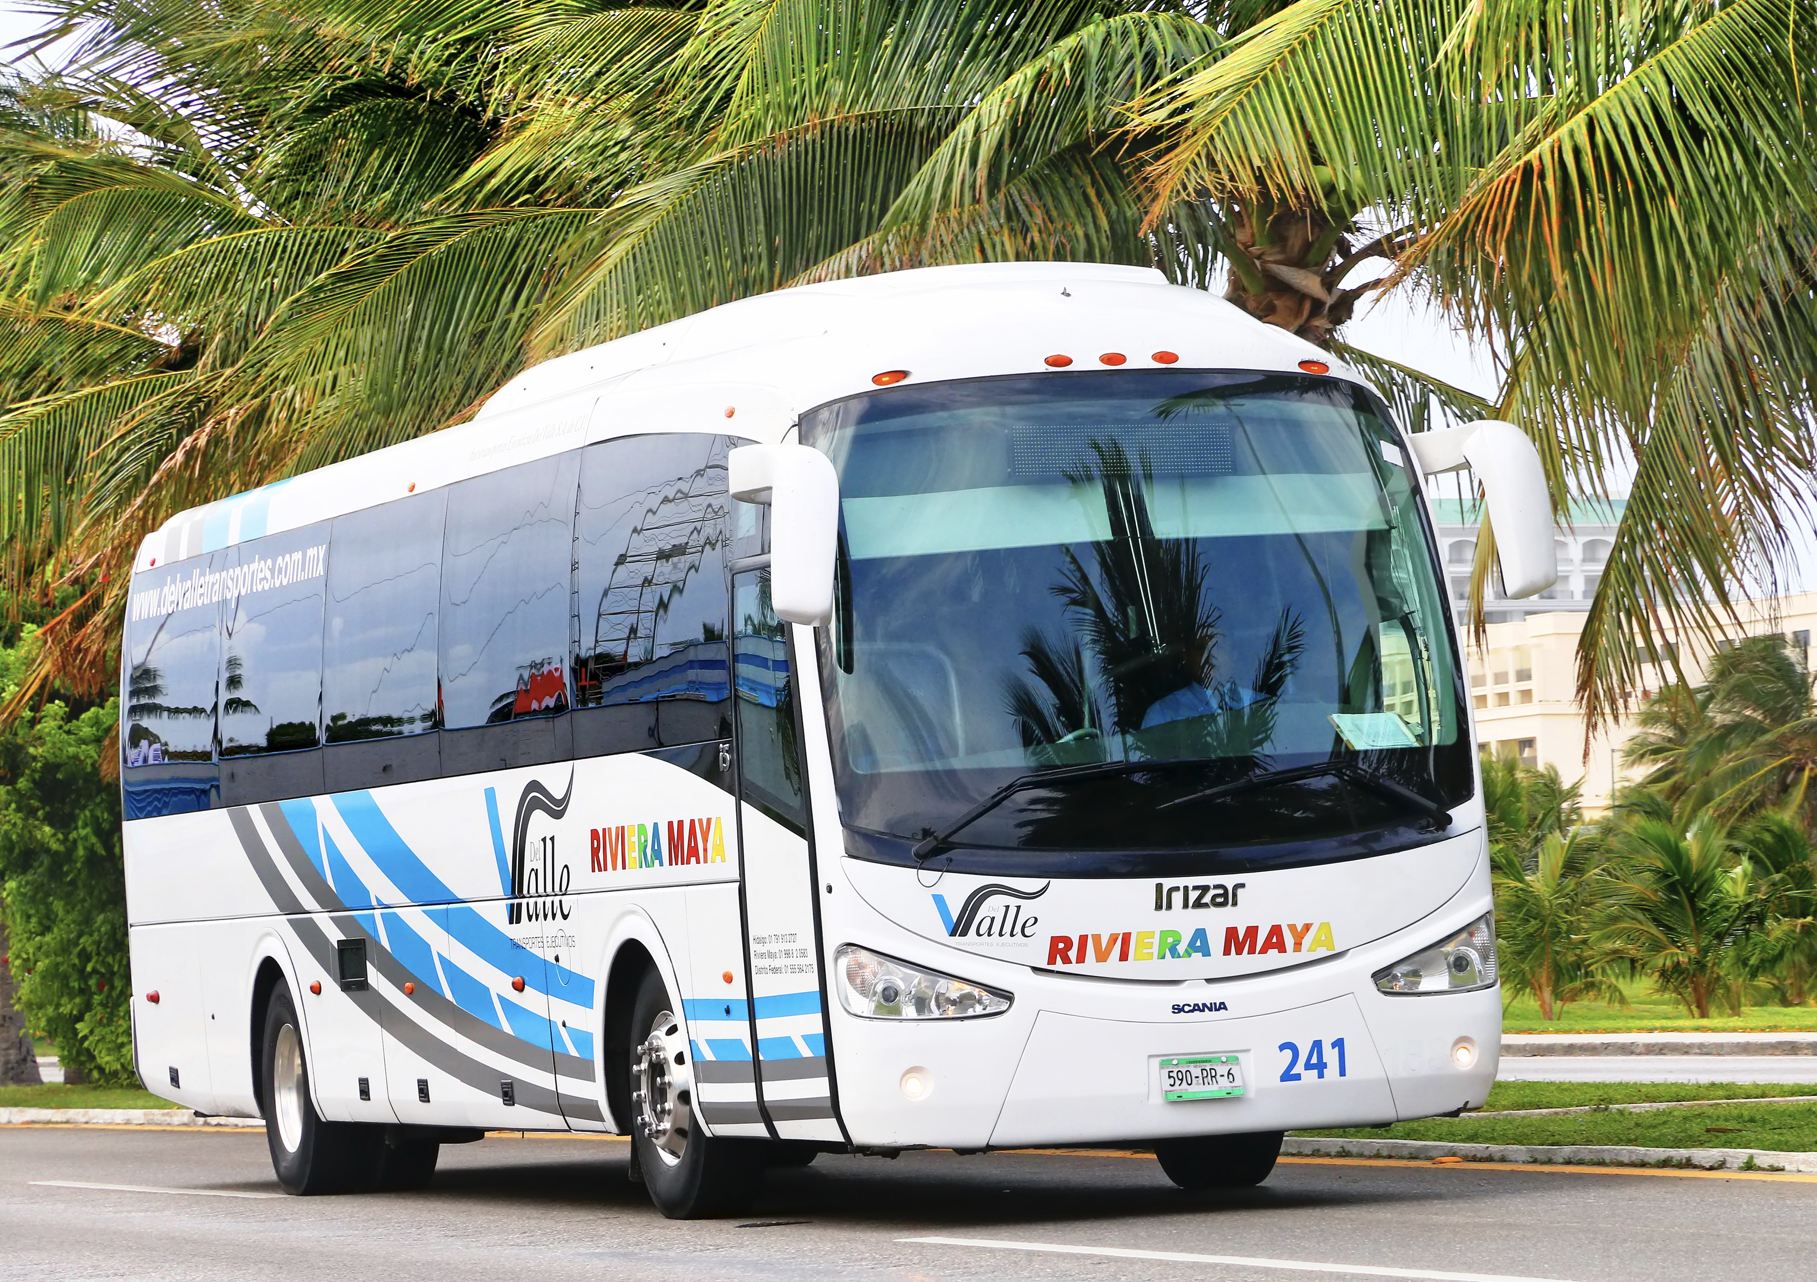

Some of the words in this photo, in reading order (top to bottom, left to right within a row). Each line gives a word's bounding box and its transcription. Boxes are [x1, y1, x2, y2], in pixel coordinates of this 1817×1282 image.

[131, 544, 326, 622] www.delvalletransportes.com.mx
[484, 762, 574, 925] Valle
[529, 840, 541, 862] Del
[590, 822, 664, 873] RIVIERA
[667, 817, 726, 867] MAYA
[931, 880, 1050, 938] Valle
[1154, 882, 1246, 911] Irizar
[510, 936, 544, 950] TRANSPORTES
[545, 935, 576, 949] EJECUTIVOS
[753, 949, 767, 960] Riviera
[1046, 928, 1212, 965] RIVIERA
[1222, 922, 1336, 957] MAYA
[754, 964, 768, 975] Distrito
[1171, 1001, 1228, 1014] SCANIA
[1278, 1037, 1346, 1082] 241
[1167, 1067, 1235, 1087] 590-RR-6
